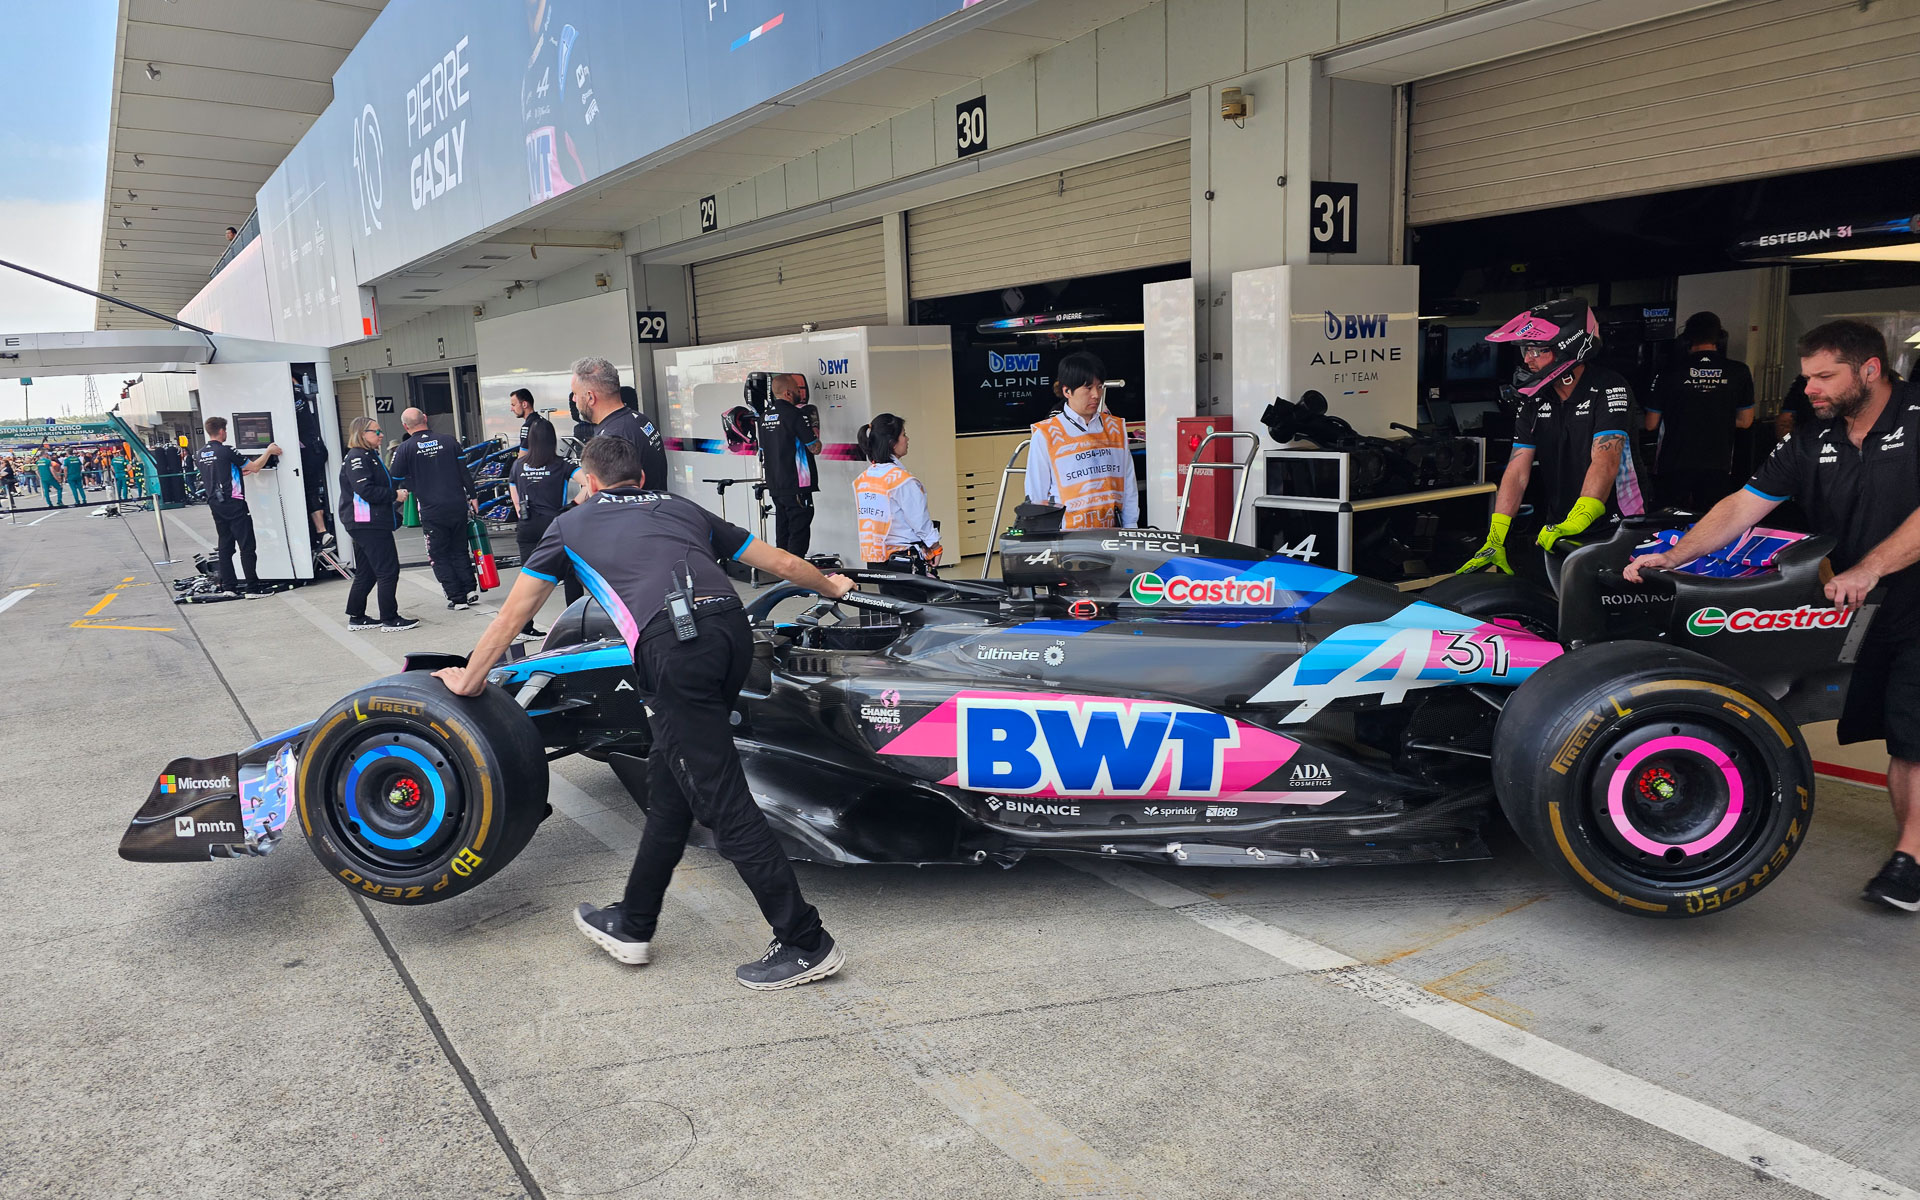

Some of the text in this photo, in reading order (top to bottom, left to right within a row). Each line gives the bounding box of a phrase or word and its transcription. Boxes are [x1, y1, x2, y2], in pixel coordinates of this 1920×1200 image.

[406, 35, 470, 147] PIERRE
[958, 107, 985, 149] 30
[410, 119, 467, 211] GASLY
[701, 199, 714, 227] 29
[1313, 194, 1350, 242] 31
[1759, 225, 1852, 247] ESTEBAN 31
[1063, 312, 1082, 320] PIERRE
[639, 317, 665, 338] 29
[1345, 314, 1388, 339] BWT
[1565, 329, 1584, 345] shamir
[1004, 353, 1040, 372] BWT
[1310, 348, 1402, 366] ALPINE
[827, 359, 848, 375] BWT
[1699, 369, 1722, 377] BWT
[814, 379, 857, 390] ALPINE
[980, 376, 1050, 389] ALPINE
[1352, 371, 1379, 382] TEAM
[377, 400, 392, 411] 27
[597, 493, 673, 504] ALPINE
[1118, 530, 1181, 540] RENAULT
[1101, 538, 1199, 554] E-TECH
[1166, 576, 1275, 605] Castrol
[1727, 605, 1854, 632] Castrol
[1056, 639, 1065, 647] bp
[977, 648, 1040, 661] ultimate
[1439, 630, 1511, 678] 31
[368, 696, 428, 717] PIRELLI
[861, 708, 900, 717] CHANGE
[869, 716, 900, 724] WORLD
[960, 700, 1238, 796] BWT
[1550, 710, 1605, 775] PIRELLI
[1289, 763, 1332, 779] ADA
[178, 775, 231, 790] Microsoft
[1006, 801, 1080, 816] BINANCE
[1160, 805, 1197, 818] sprinklr
[1216, 807, 1238, 817] BRB
[197, 820, 236, 833] mntn
[1722, 817, 1802, 903] ZERO
[339, 868, 425, 898] ZERO
